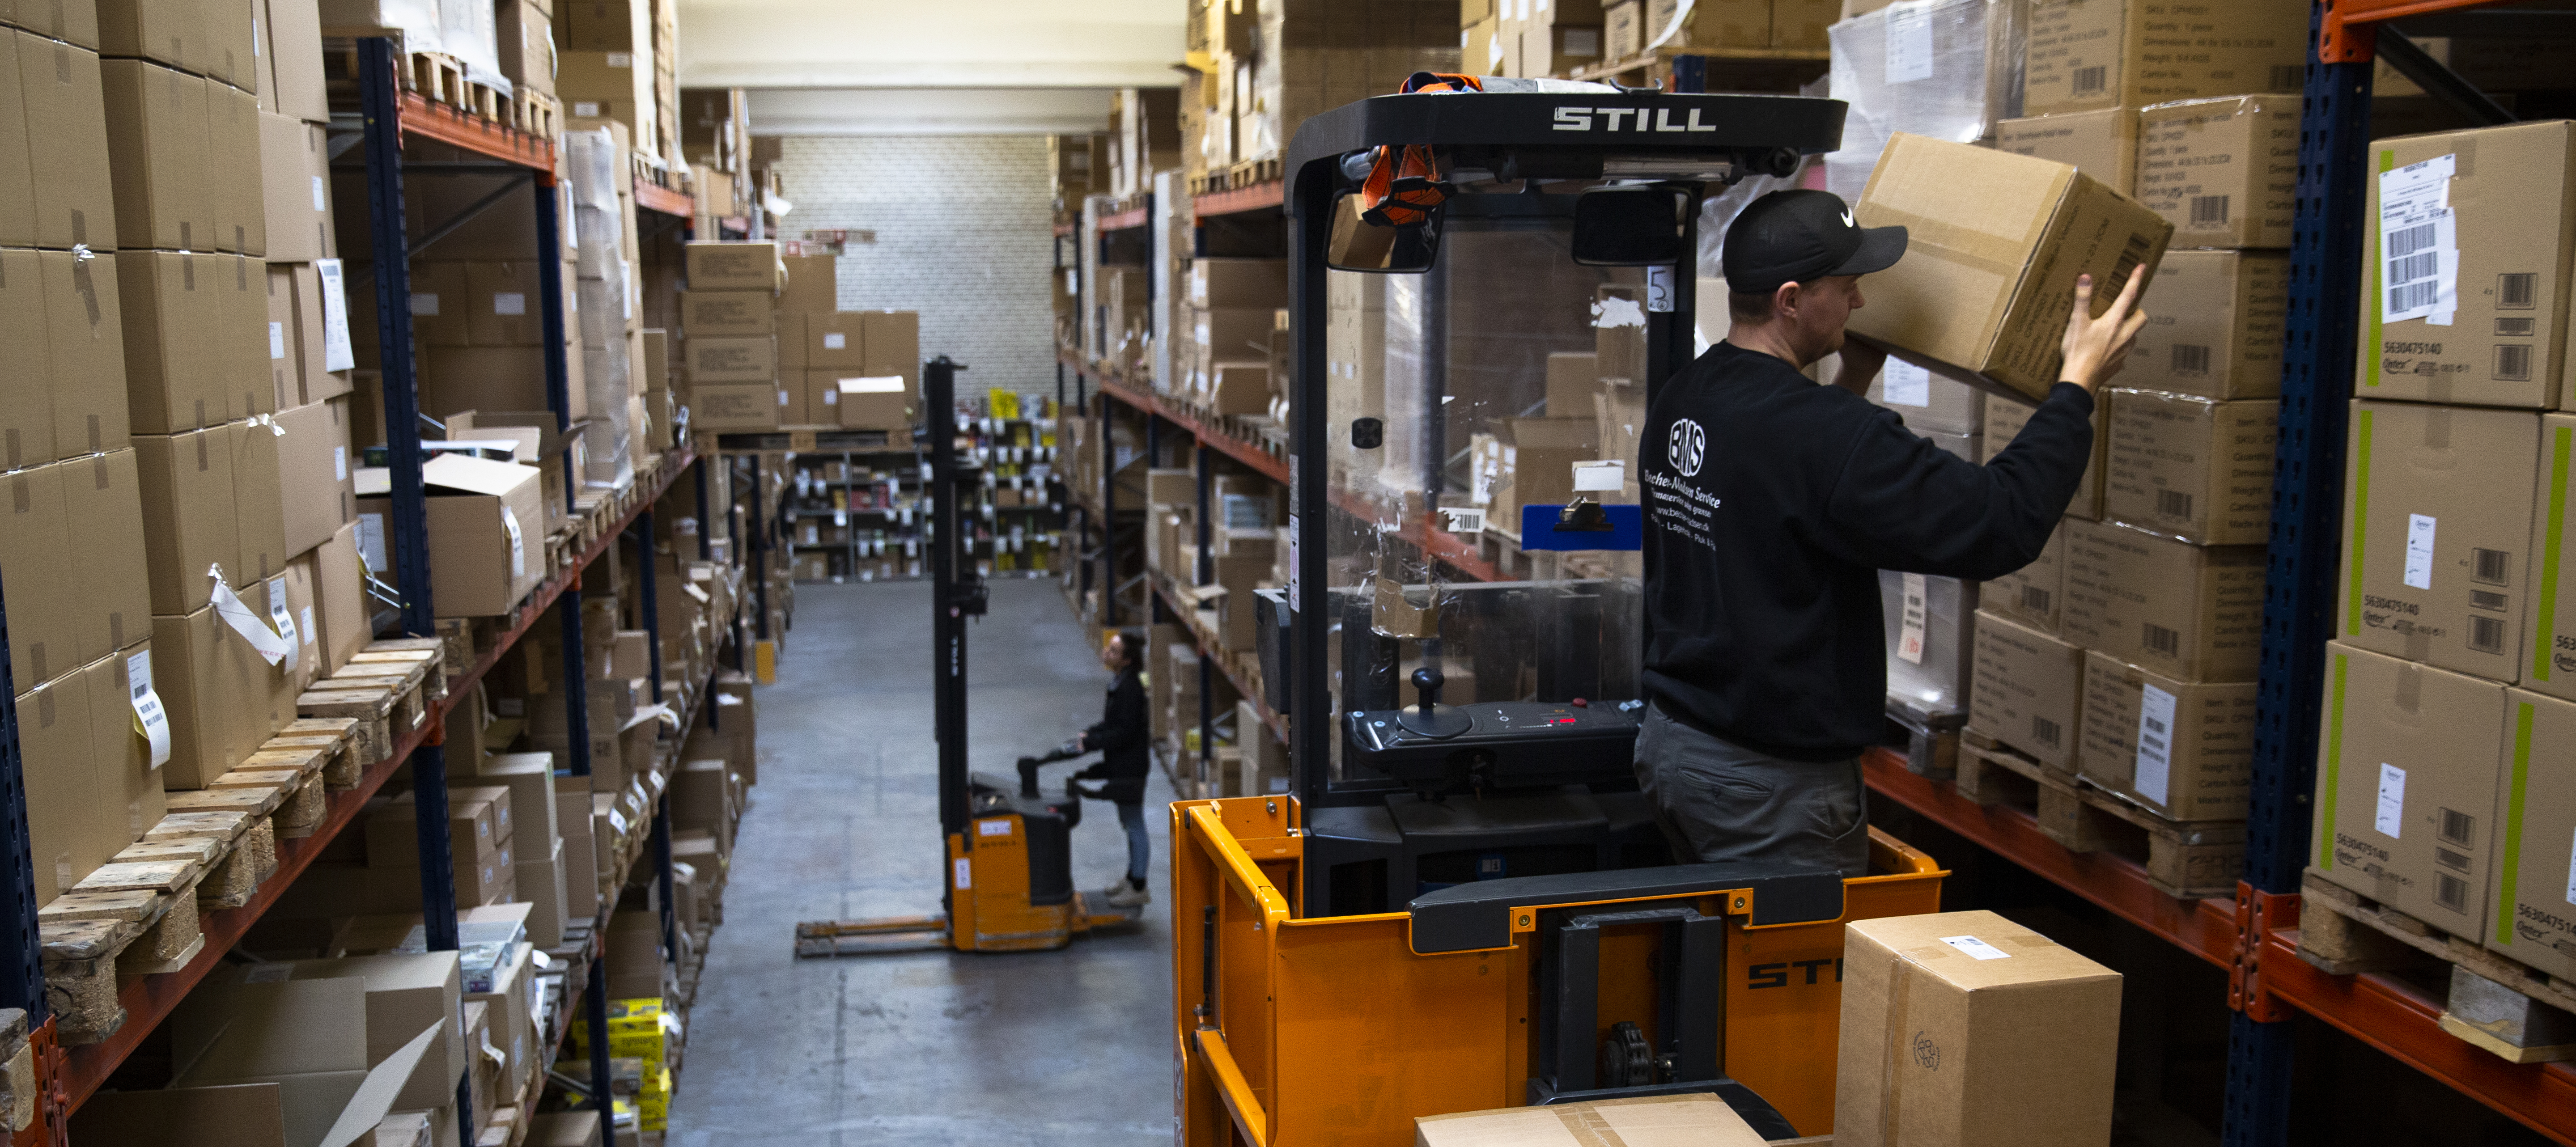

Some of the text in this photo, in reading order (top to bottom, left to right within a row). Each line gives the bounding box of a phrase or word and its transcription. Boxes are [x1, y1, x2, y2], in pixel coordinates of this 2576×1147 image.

[1553, 106, 1717, 132] STILL
[2383, 341, 2442, 355] 5630475140
[1668, 419, 1705, 477] BMS
[1695, 486, 1721, 509] Service
[2364, 594, 2420, 616] 5630475140
